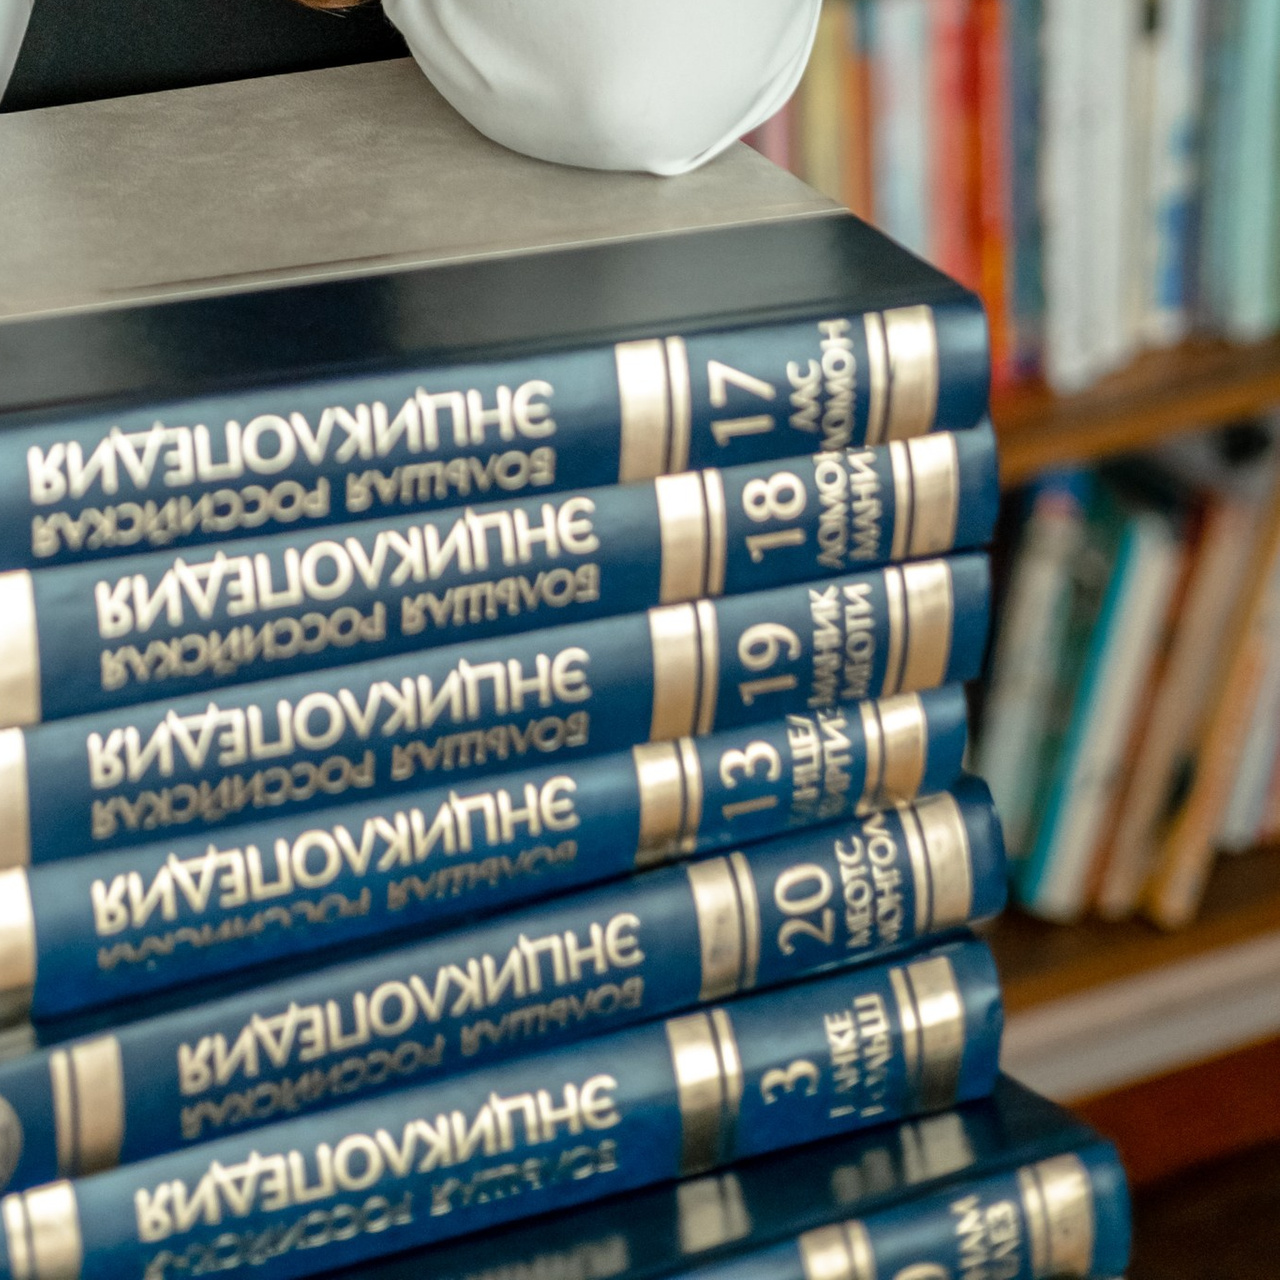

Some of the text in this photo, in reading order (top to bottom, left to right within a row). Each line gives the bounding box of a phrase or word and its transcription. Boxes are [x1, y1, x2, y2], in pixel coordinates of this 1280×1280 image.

[27, 380, 556, 505] ЭНЦИКЛОПЕДИЯ
[707, 359, 776, 447] 17
[31, 446, 556, 557] БОЛЬШАЯ РОССИЙСКАЯ
[742, 471, 807, 563] 18
[847, 445, 882, 561] МАНИ
[95, 497, 600, 638] ЭНЦИКЛОПЕДИЯ
[101, 562, 601, 690] БОЛЬШАЯ РОССИЙСКАЯ
[87, 647, 591, 789] ЭНЦИКЛОПЕДИЯ
[737, 622, 802, 707] 19
[91, 711, 590, 839] БОЛЬШАЯ РОССИЙСКАЯ
[719, 739, 782, 821] 13
[91, 776, 581, 936] ЭНЦИКЛОПЕДИЯ
[773, 862, 835, 956] 20
[178, 913, 644, 1096] ЭНЦИКЛОПЕДИЯ
[181, 977, 644, 1140] БОЛЬШАЯ РОССИЙСКАЯ
[760, 1059, 820, 1105] 3
[134, 1074, 619, 1241] ЭНЦИКЛОПЕДИЯ
